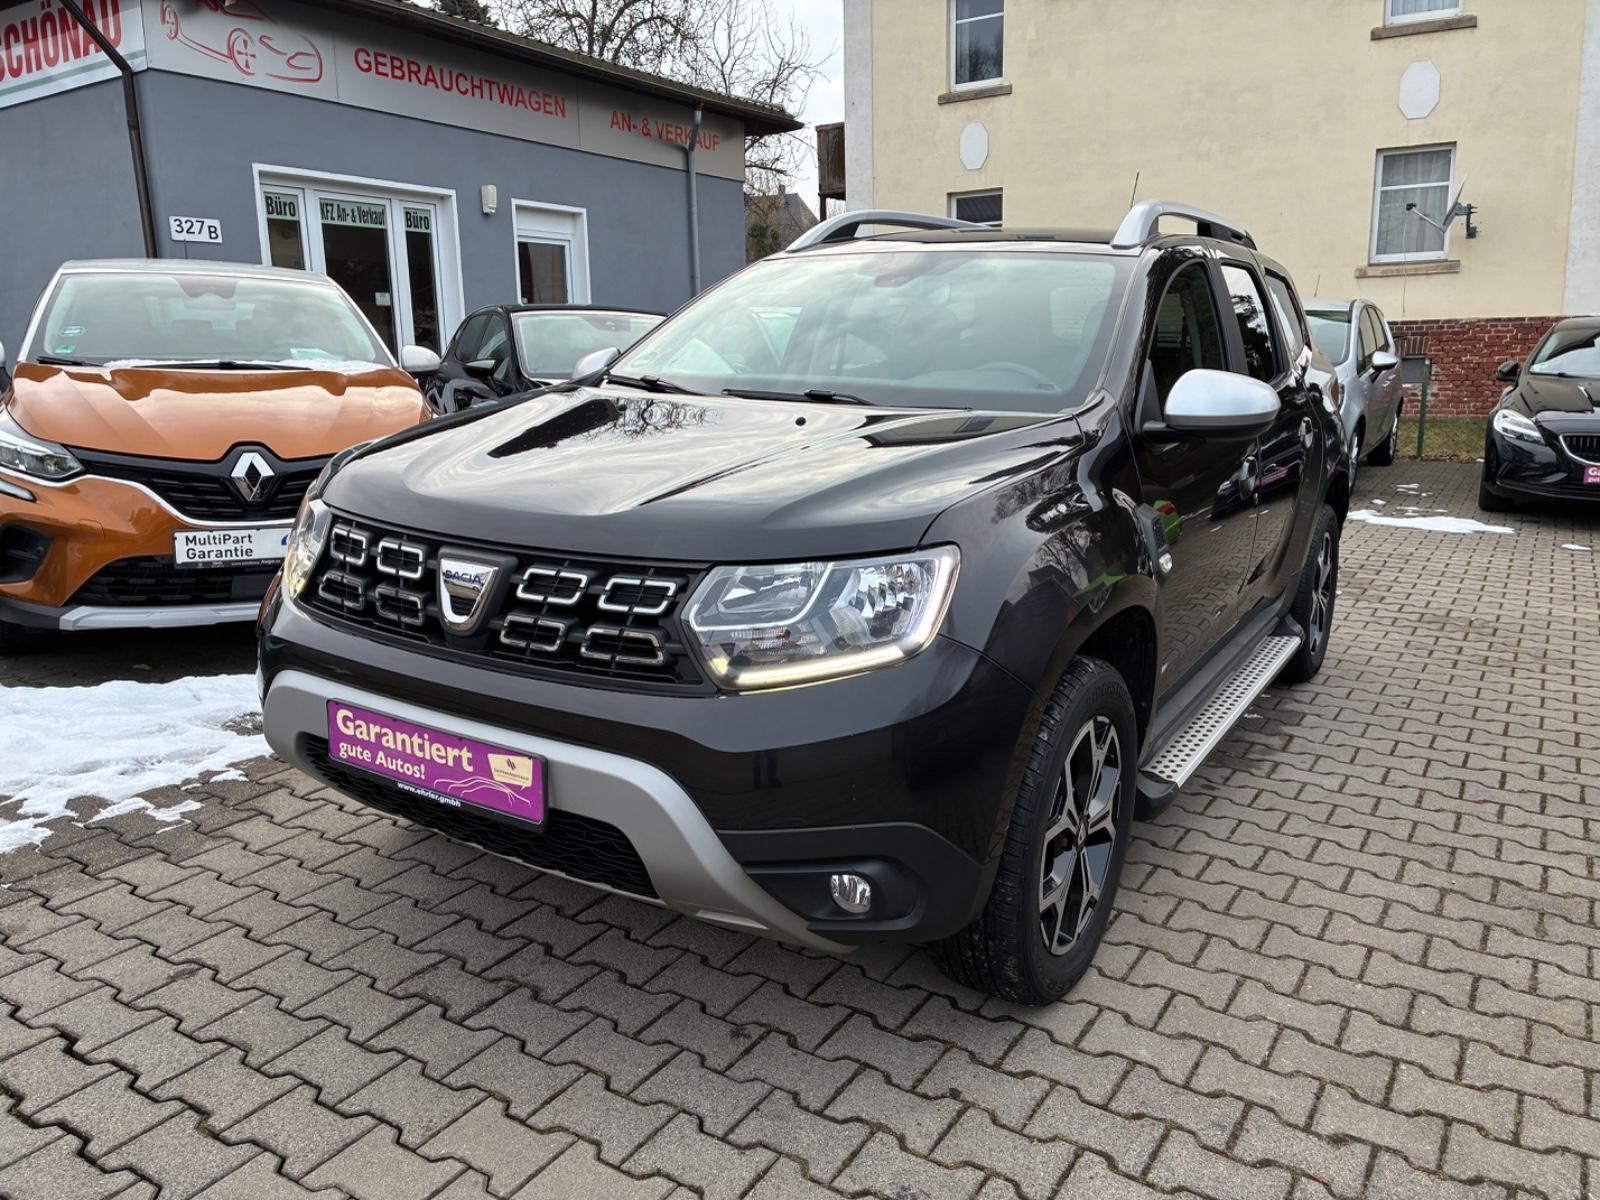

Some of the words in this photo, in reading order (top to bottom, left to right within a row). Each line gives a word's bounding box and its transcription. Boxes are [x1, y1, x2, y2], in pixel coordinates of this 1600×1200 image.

[0, 0, 121, 84] CHÖNAU
[354, 47, 566, 118] GEBRAUCHTWAGEN
[610, 110, 637, 132] AN-
[641, 118, 652, 137] &
[265, 196, 296, 217] Büro
[320, 202, 335, 220] KFZ
[337, 204, 349, 222] An-
[351, 206, 357, 223] &
[358, 206, 385, 225] Verkauf
[174, 218, 204, 234] 327
[207, 225, 219, 240] B
[406, 211, 430, 230] Büro
[185, 534, 252, 546] MultiPart
[186, 546, 253, 560] Garantie
[444, 569, 481, 585] DACIA
[336, 708, 474, 773] Garantiert
[339, 742, 371, 762] gute
[375, 751, 426, 780] Autos!
